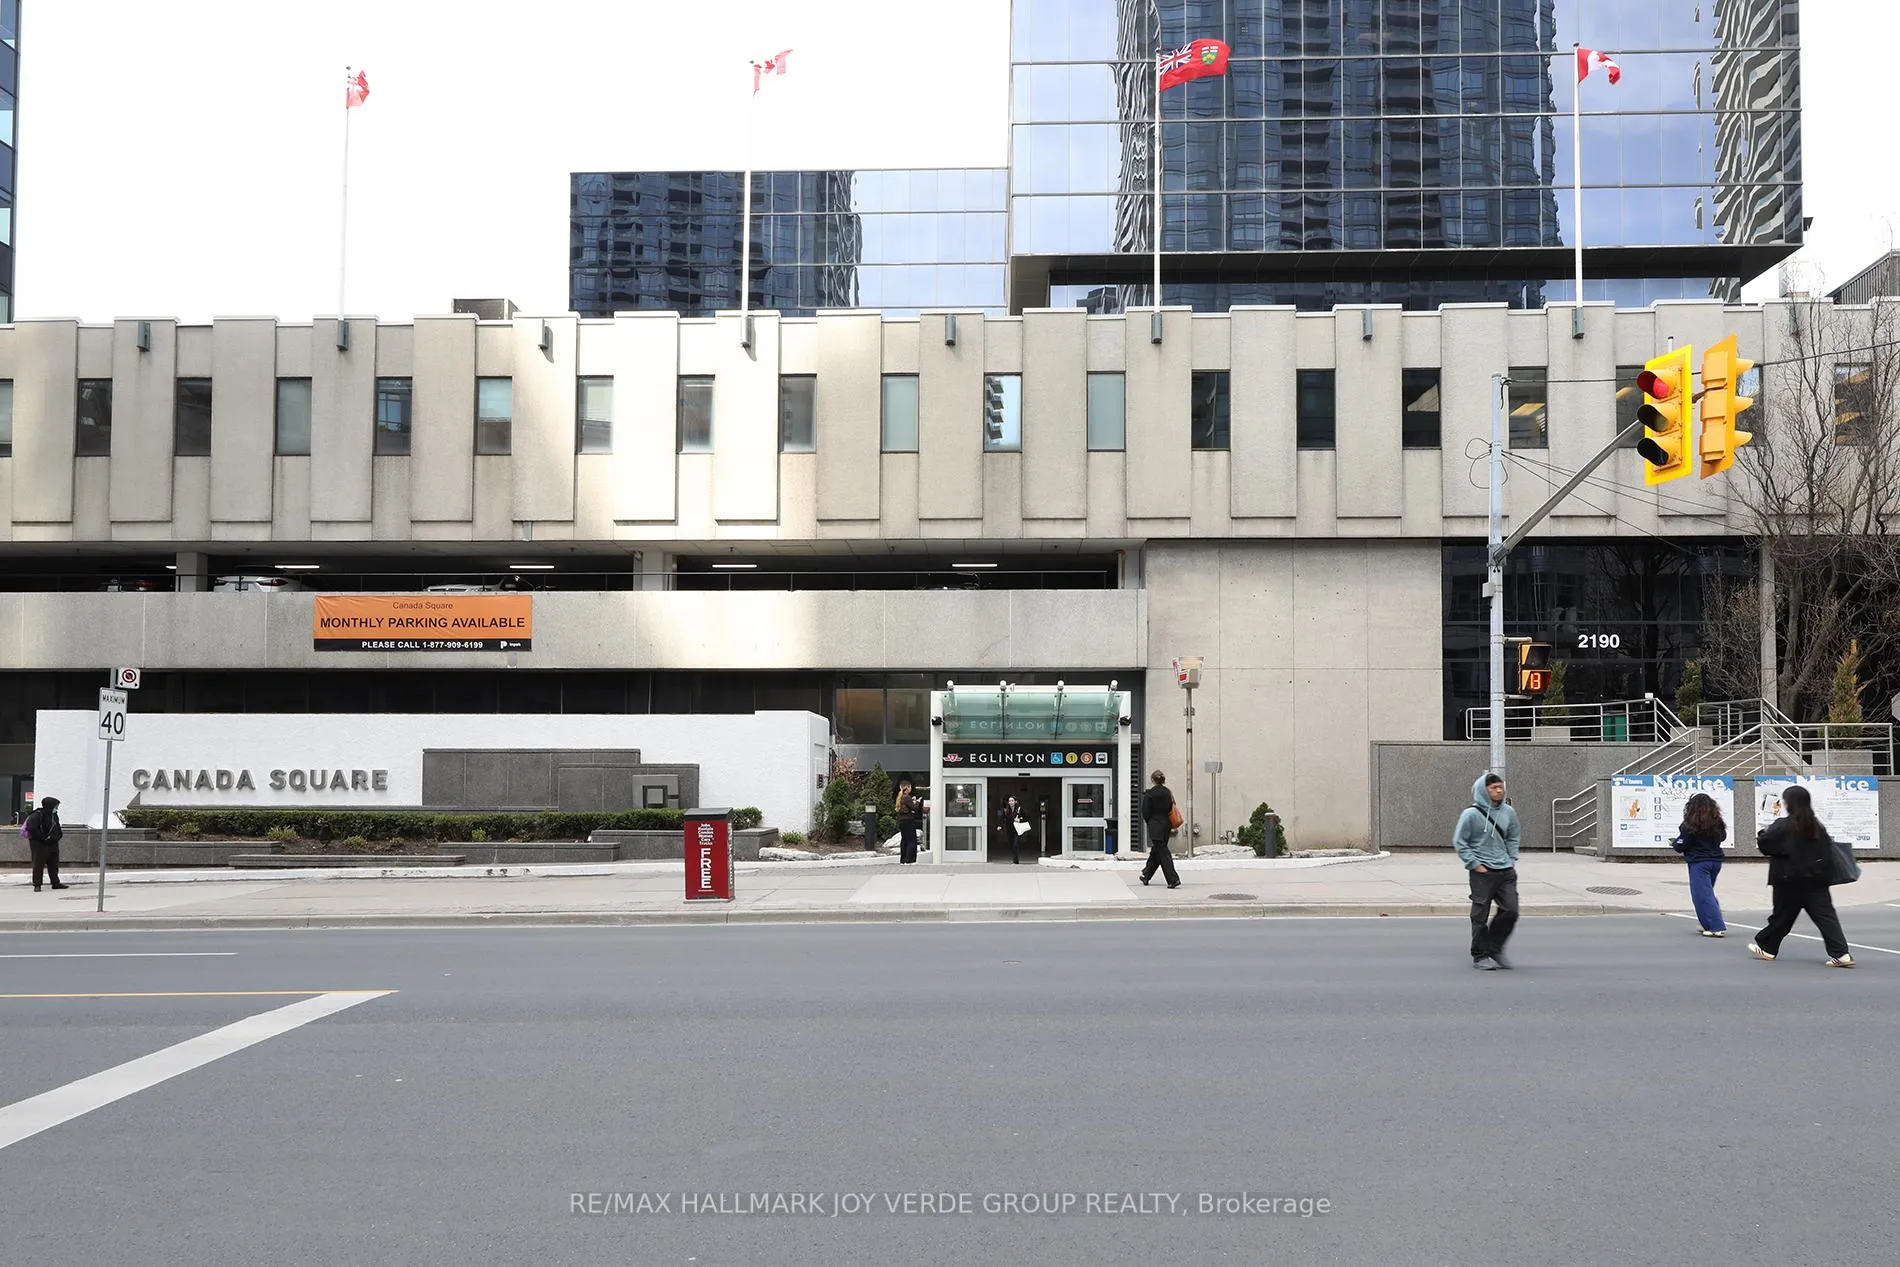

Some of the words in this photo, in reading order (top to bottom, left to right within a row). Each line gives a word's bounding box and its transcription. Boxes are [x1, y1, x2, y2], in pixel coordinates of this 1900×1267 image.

[392, 601, 423, 610] Canada
[425, 601, 454, 611] Square
[320, 617, 384, 628] MONTHLY
[388, 617, 448, 628] PARKING
[451, 617, 525, 628] AVAILABLE
[361, 641, 396, 649] PLEASE
[397, 641, 420, 649] CALL
[422, 641, 483, 649] 1-877-909-6199
[1578, 634, 1620, 648] 2190
[1530, 673, 1541, 690] 13
[101, 711, 124, 735] 40
[969, 753, 1045, 763] EGLINTON
[132, 768, 256, 791] CANADA
[269, 768, 389, 792] SQUARE
[1654, 774, 1725, 792] Notice
[700, 847, 712, 889] FREE
